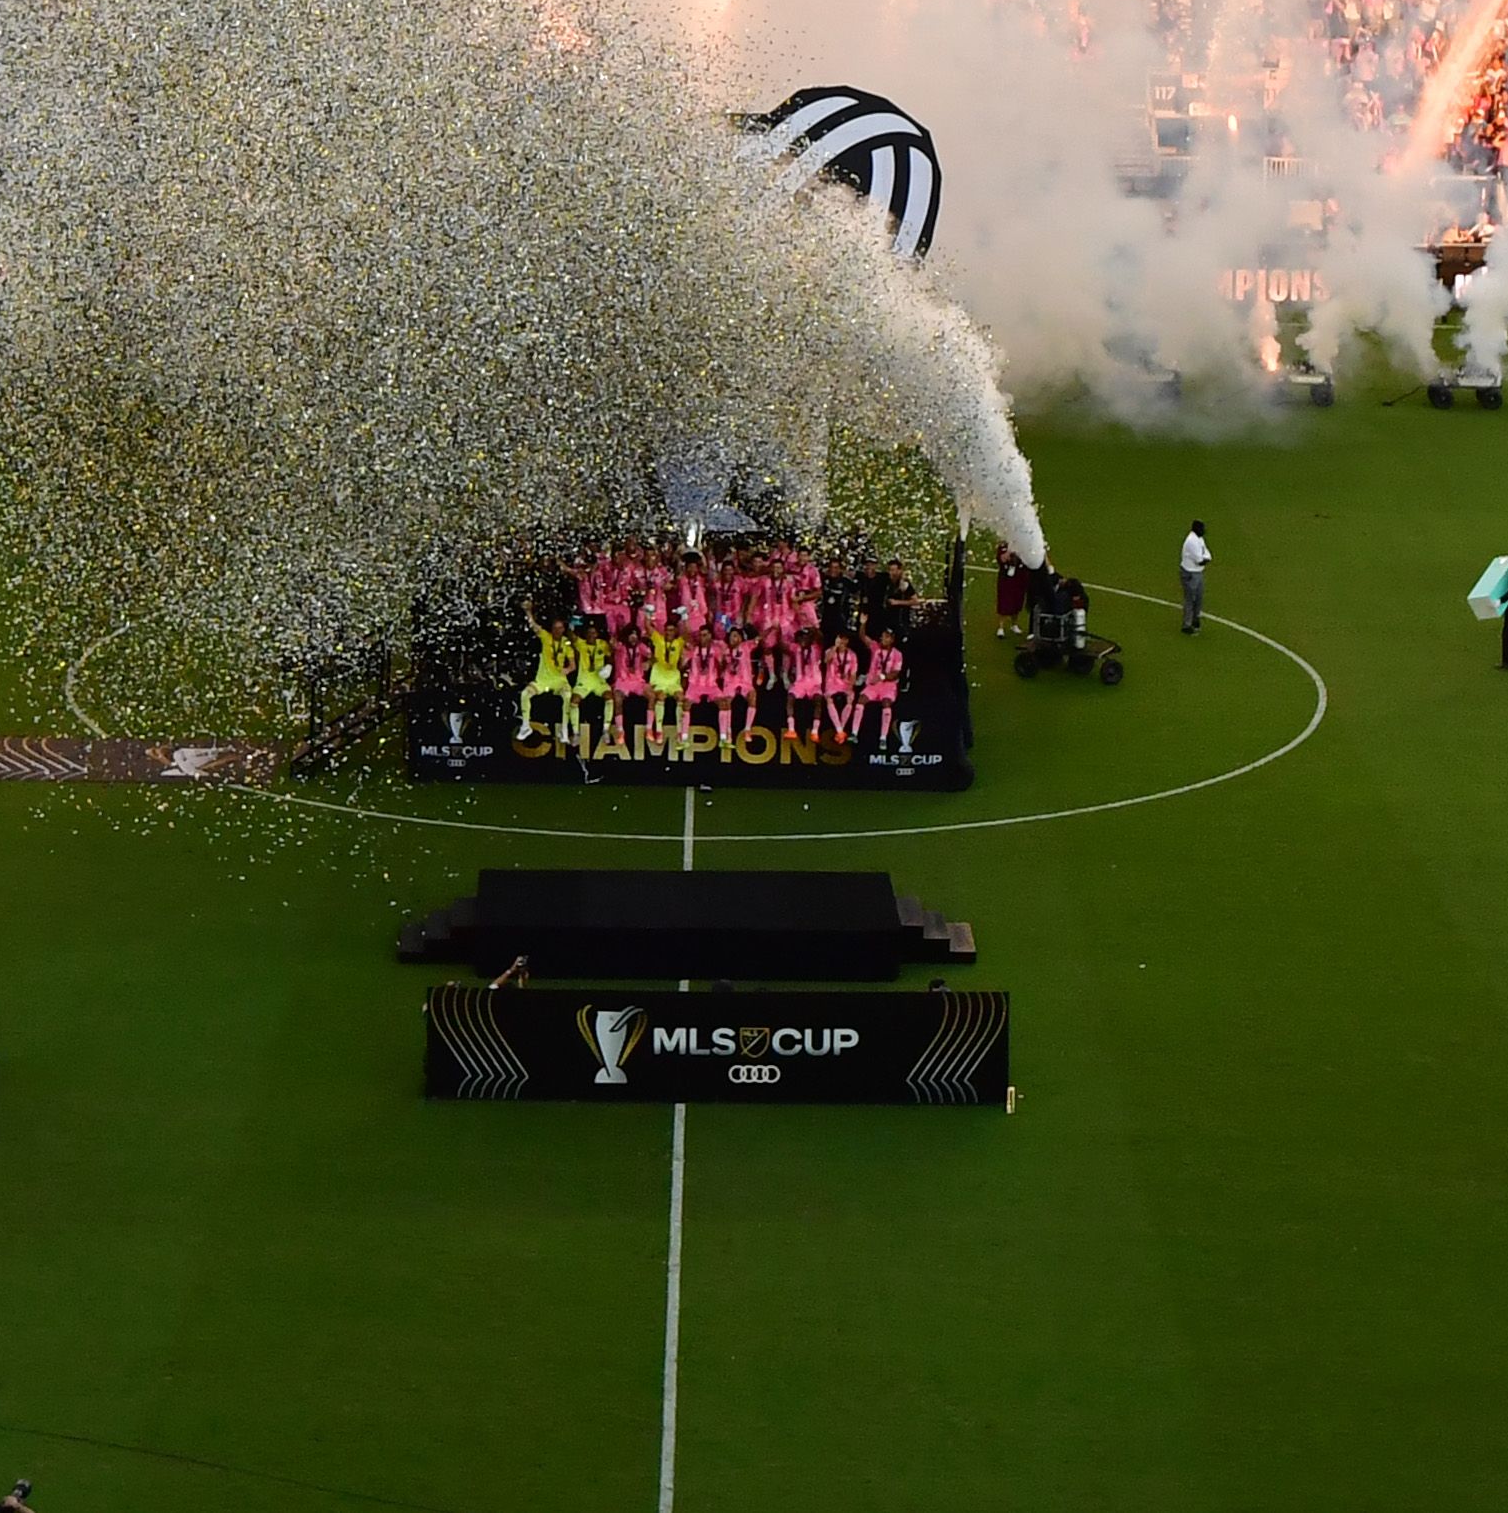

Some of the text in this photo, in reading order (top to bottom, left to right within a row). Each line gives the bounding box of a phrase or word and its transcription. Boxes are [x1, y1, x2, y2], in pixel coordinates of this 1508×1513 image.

[1155, 86, 1176, 100] 117
[421, 746, 493, 757] MLS CUP
[869, 754, 942, 765] MLS CUP
[653, 1027, 860, 1056] MLS CUP
